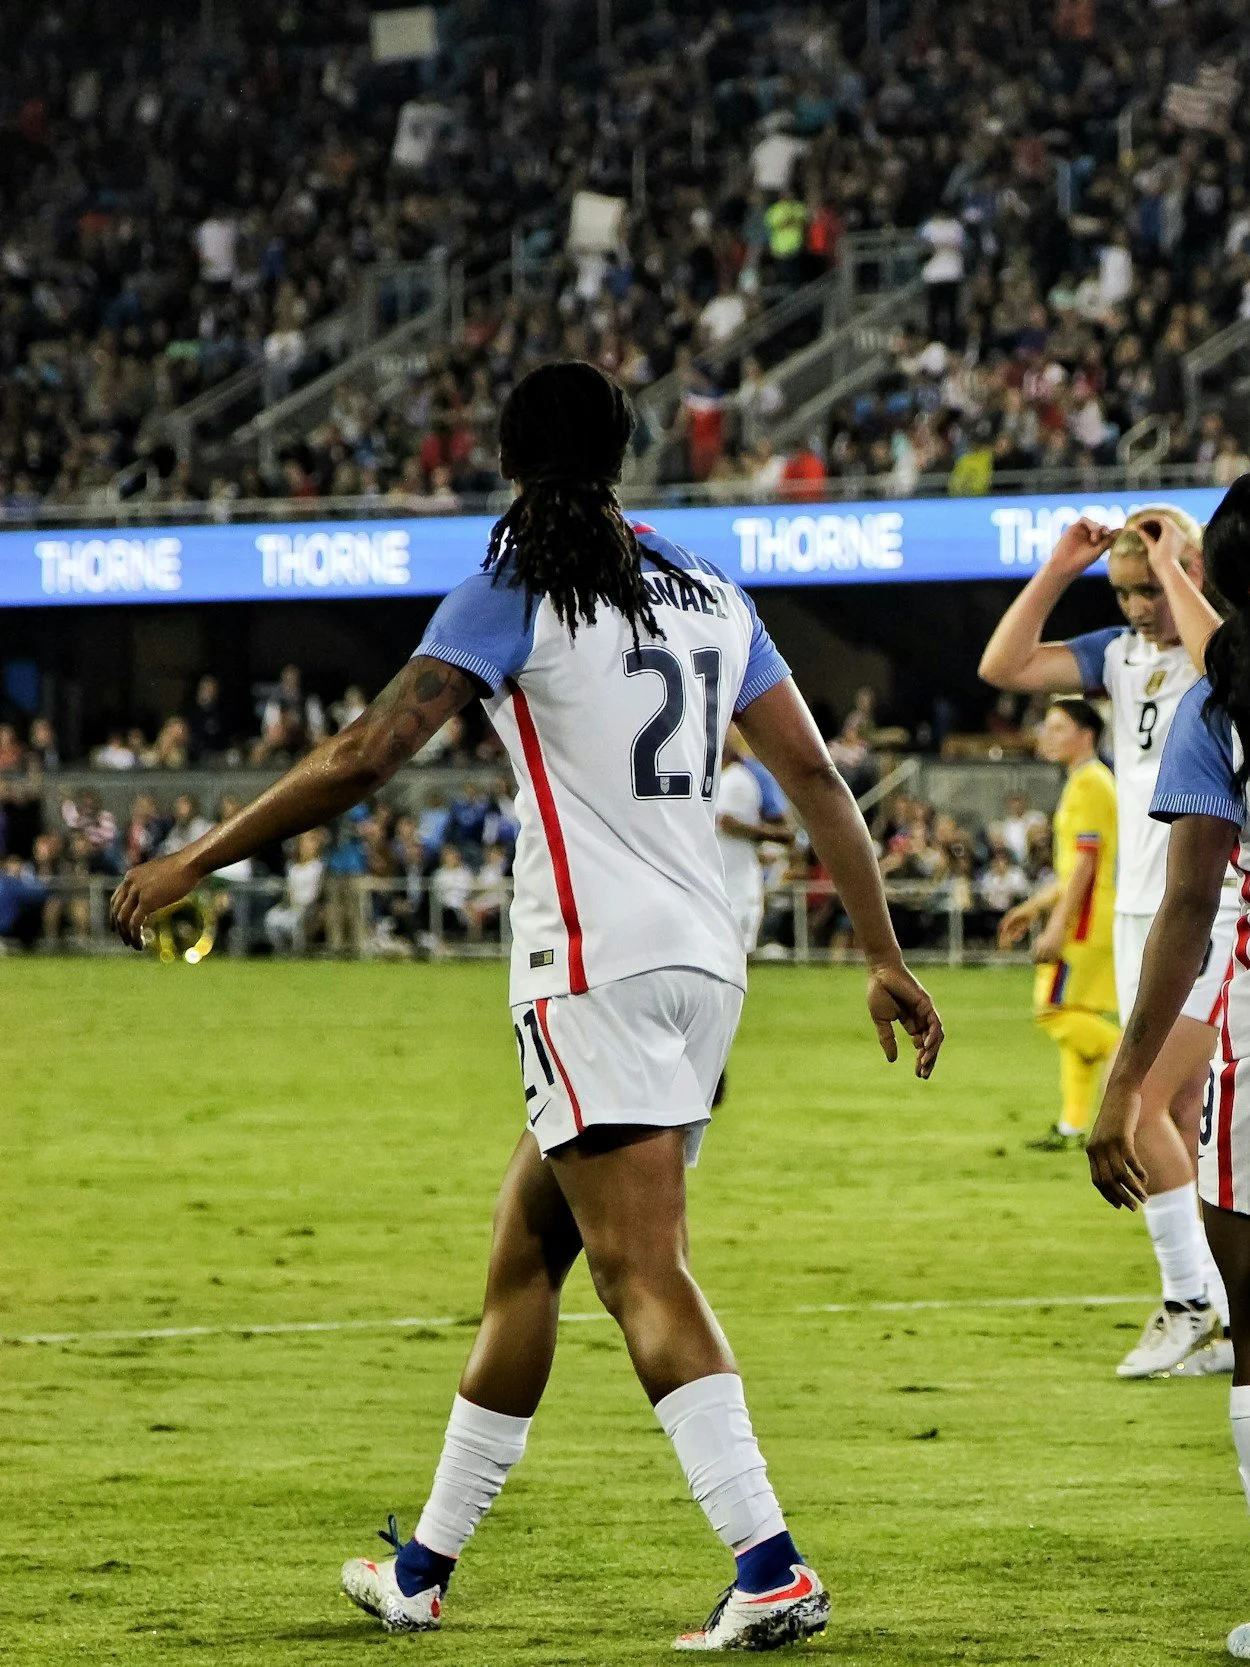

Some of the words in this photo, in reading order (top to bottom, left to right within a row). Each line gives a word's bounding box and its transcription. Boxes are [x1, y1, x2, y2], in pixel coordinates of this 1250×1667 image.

[35, 538, 183, 594] THORNE
[256, 530, 411, 588] THORNE
[733, 512, 903, 573] THORNE
[622, 644, 722, 802] 21
[1139, 701, 1157, 750] 9
